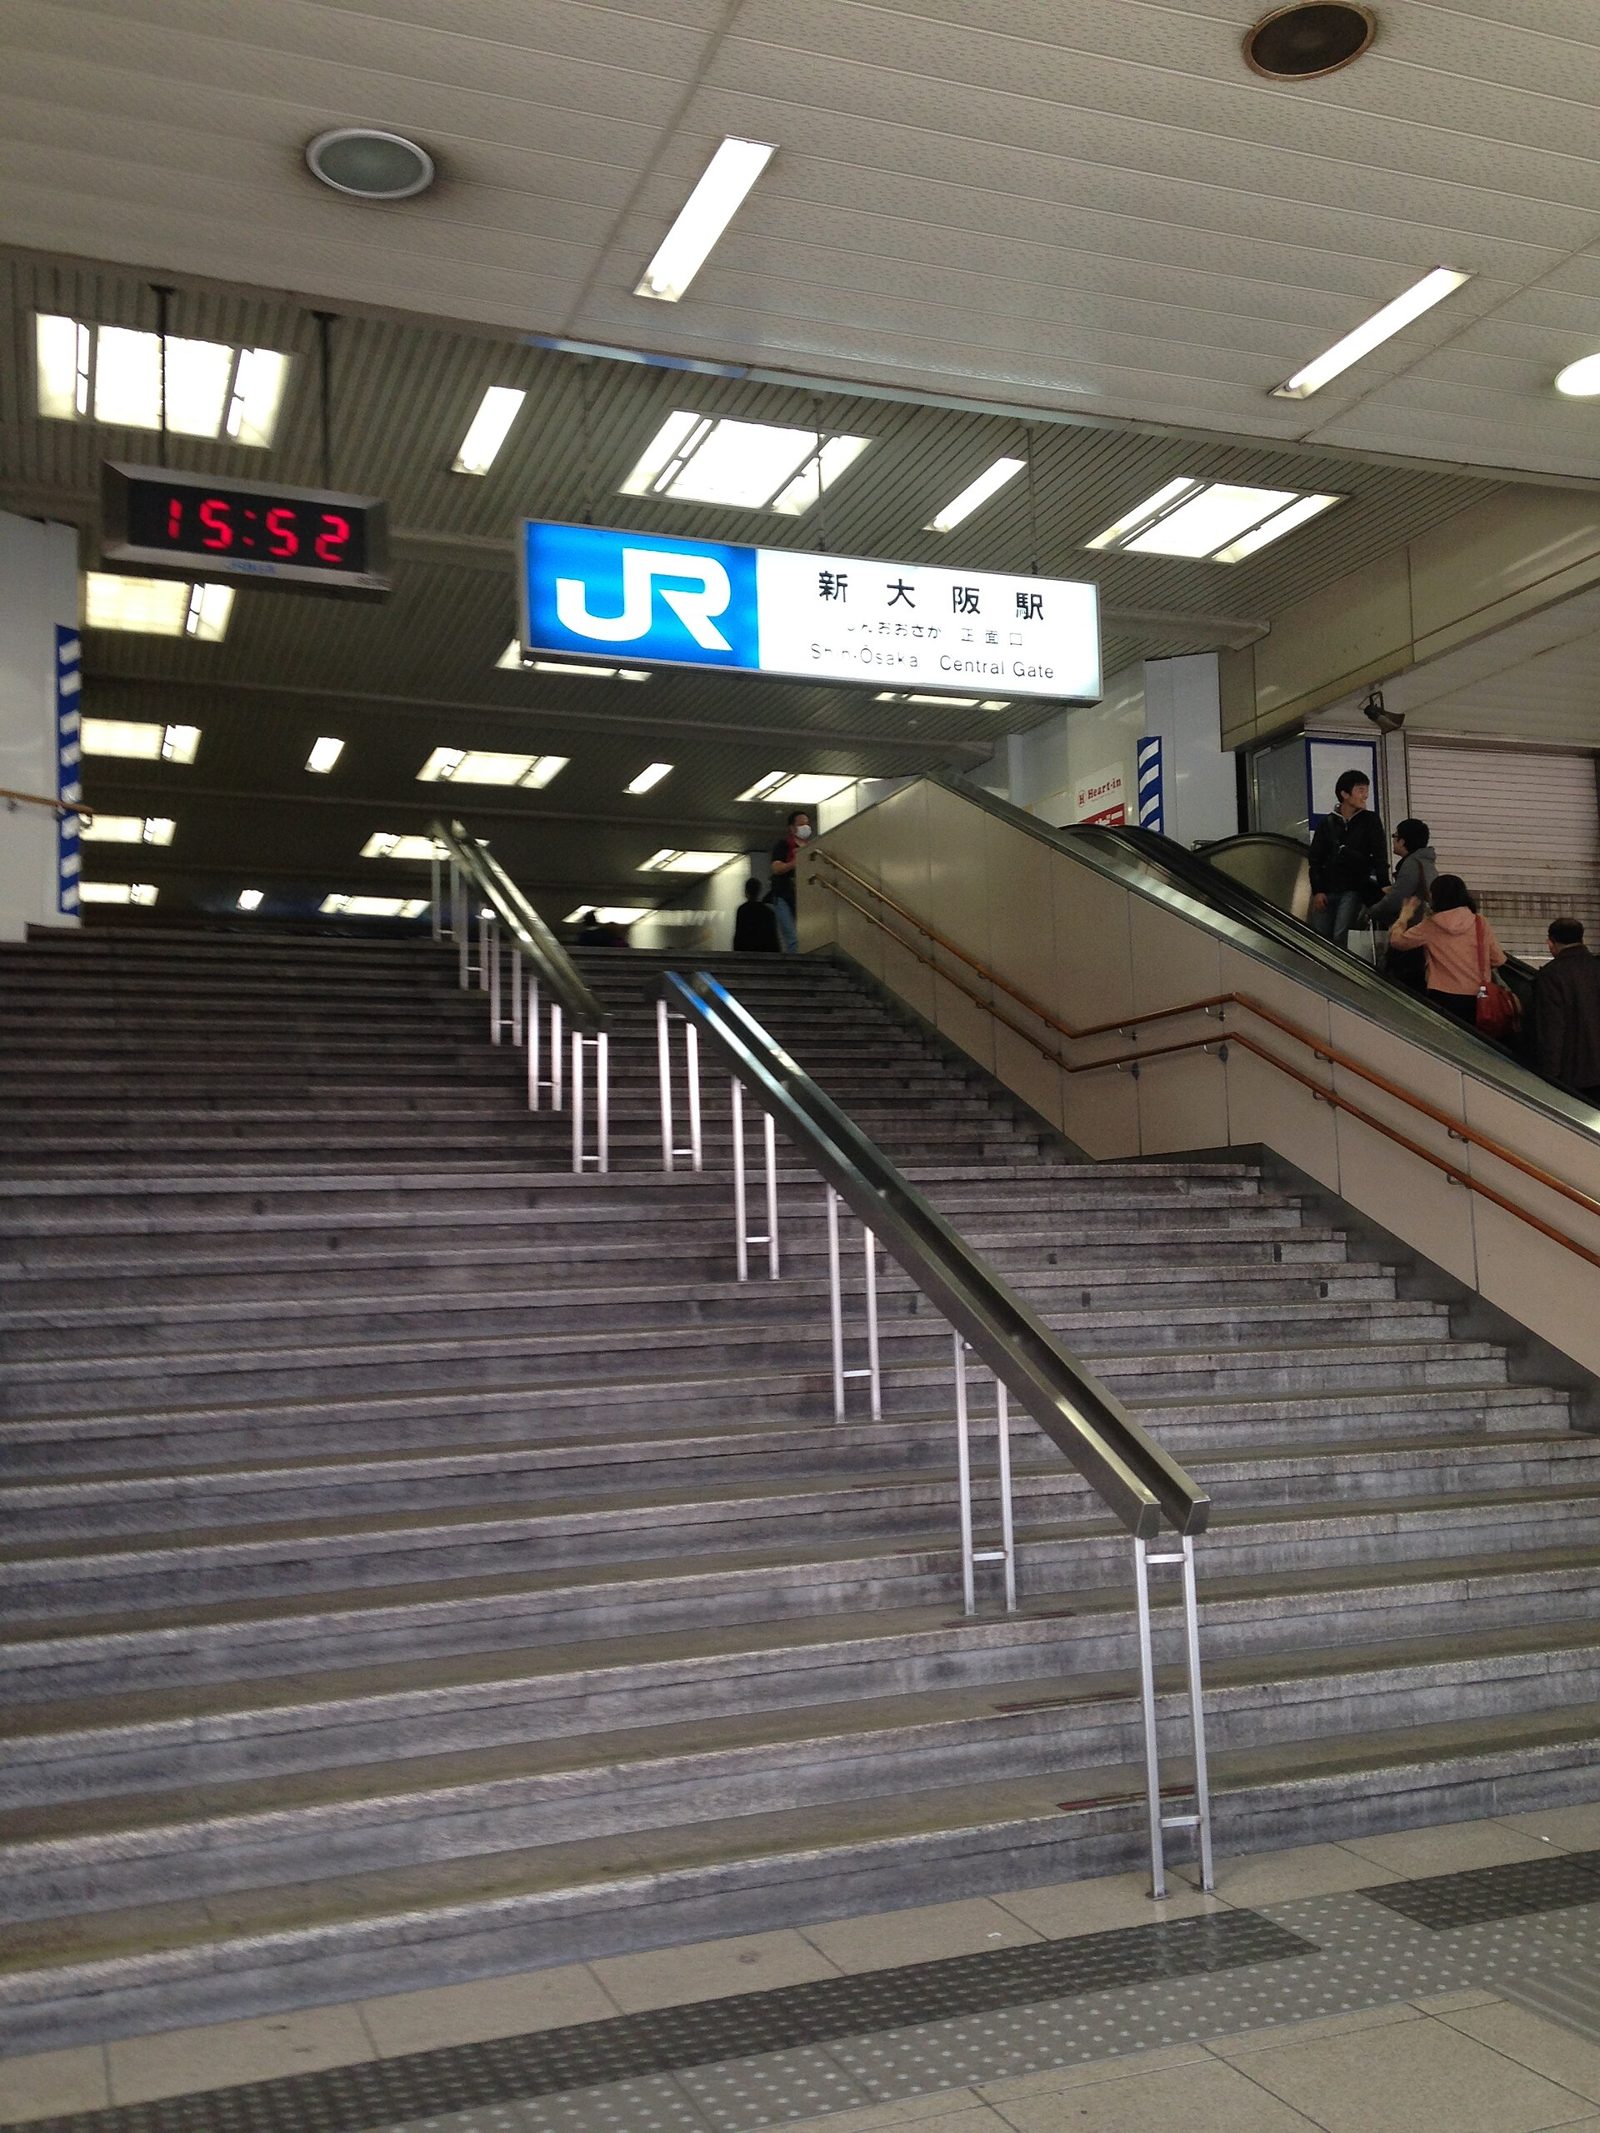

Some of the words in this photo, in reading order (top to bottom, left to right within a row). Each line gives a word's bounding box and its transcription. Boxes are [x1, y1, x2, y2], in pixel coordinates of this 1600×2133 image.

[167, 498, 351, 563] 15:52
[556, 548, 733, 651] JR
[818, 570, 1044, 621] 新大阪駅
[939, 654, 1005, 676] Central
[1012, 661, 1055, 680] Gate
